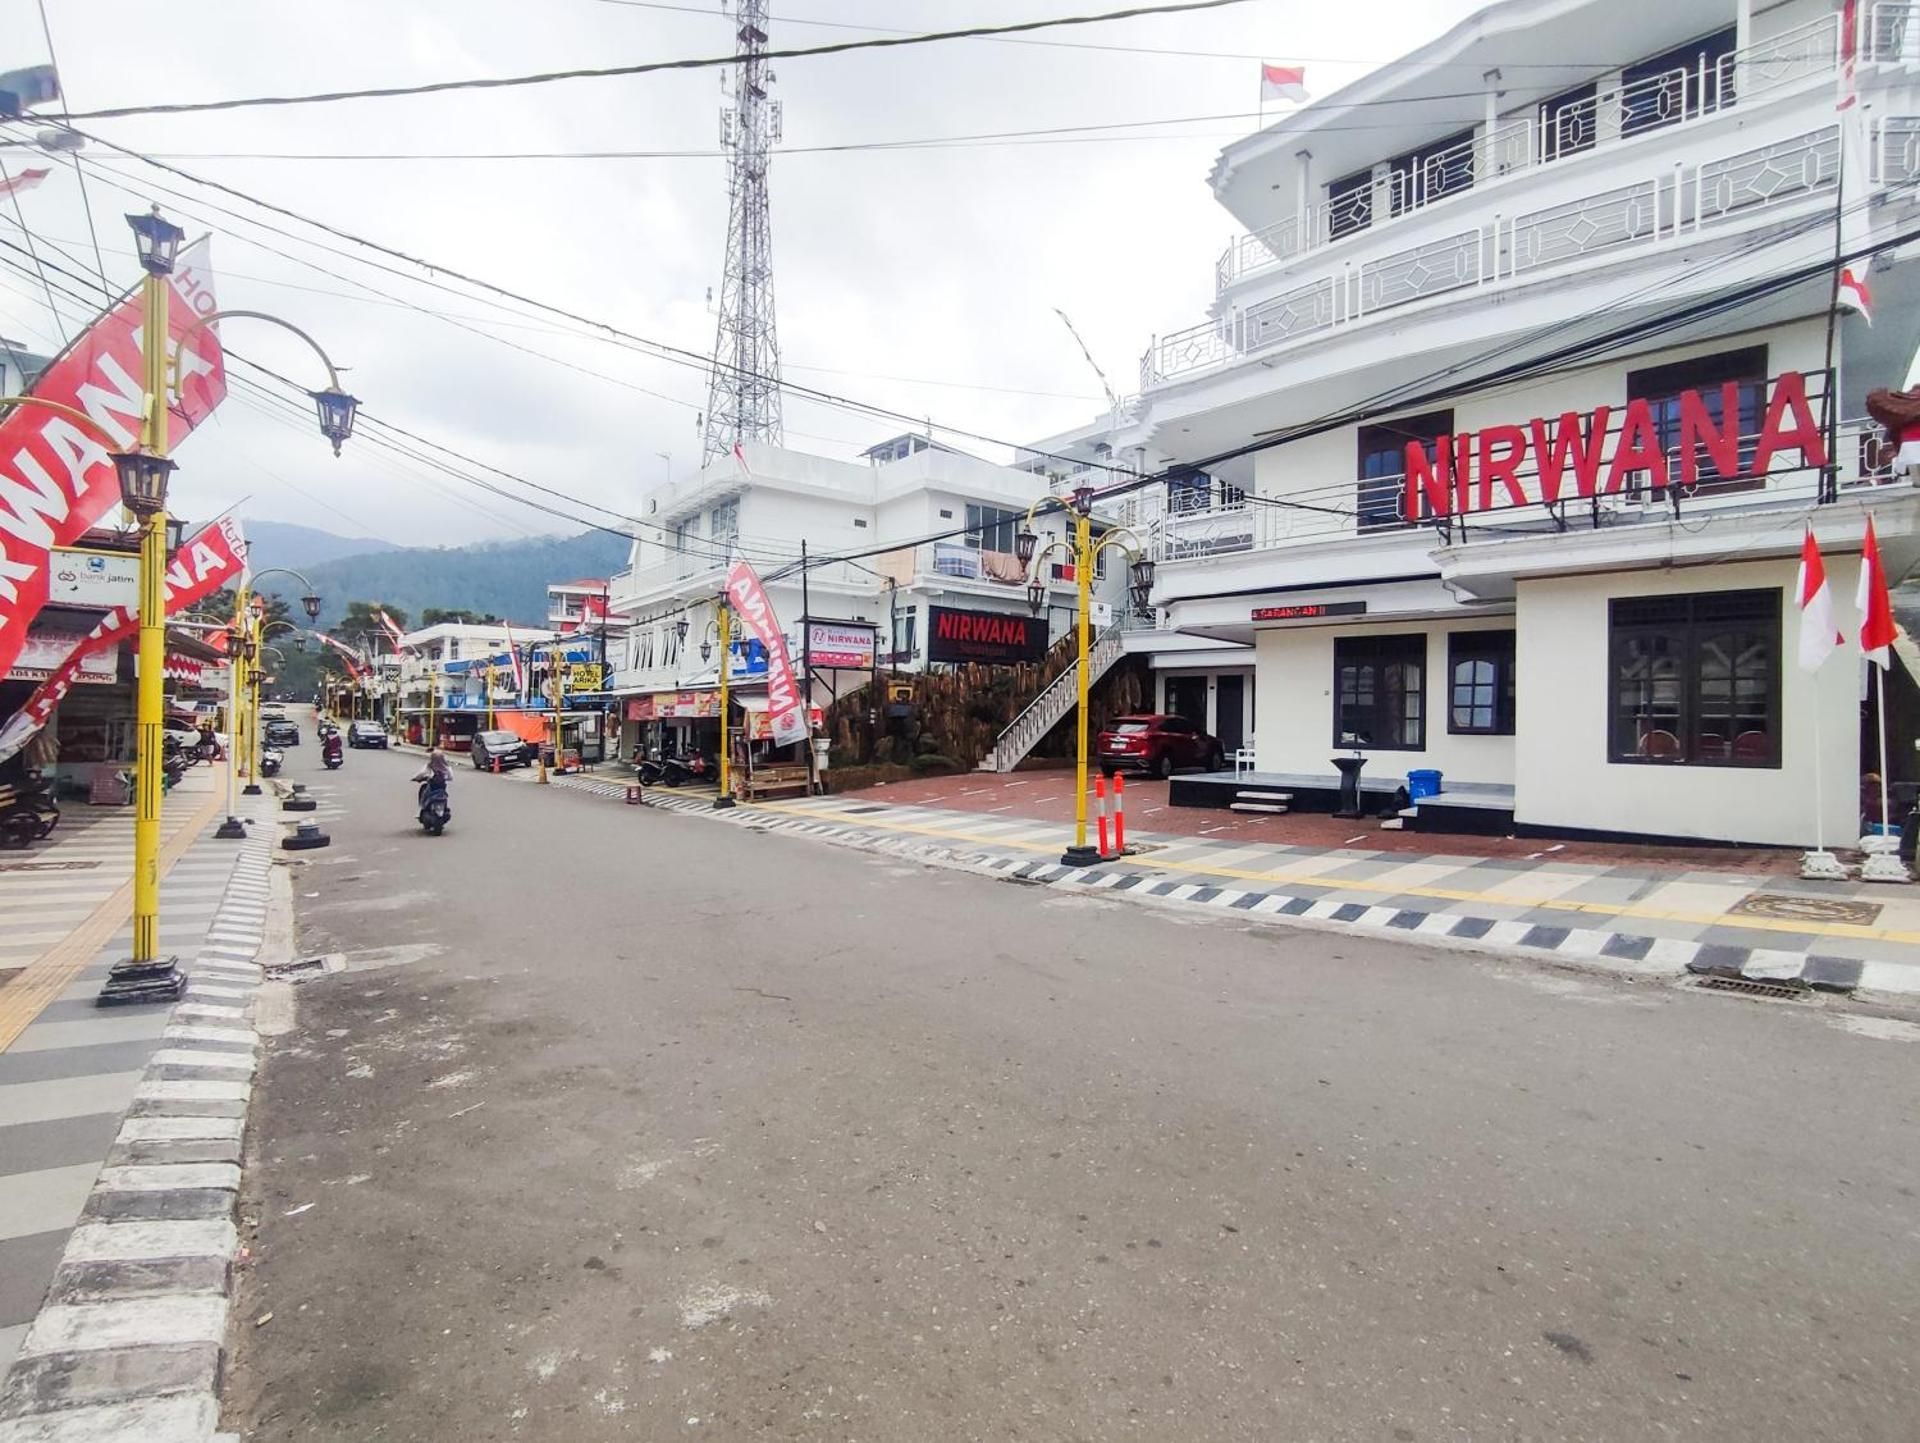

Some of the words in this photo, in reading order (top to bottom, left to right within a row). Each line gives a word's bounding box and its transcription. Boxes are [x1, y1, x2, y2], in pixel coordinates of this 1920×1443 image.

[1405, 372, 1828, 522] NIRWANA
[80, 571, 105, 581] bank
[106, 575, 135, 584] jatim
[827, 634, 872, 645] NIRWANA
[938, 612, 1026, 645] NIRWANA
